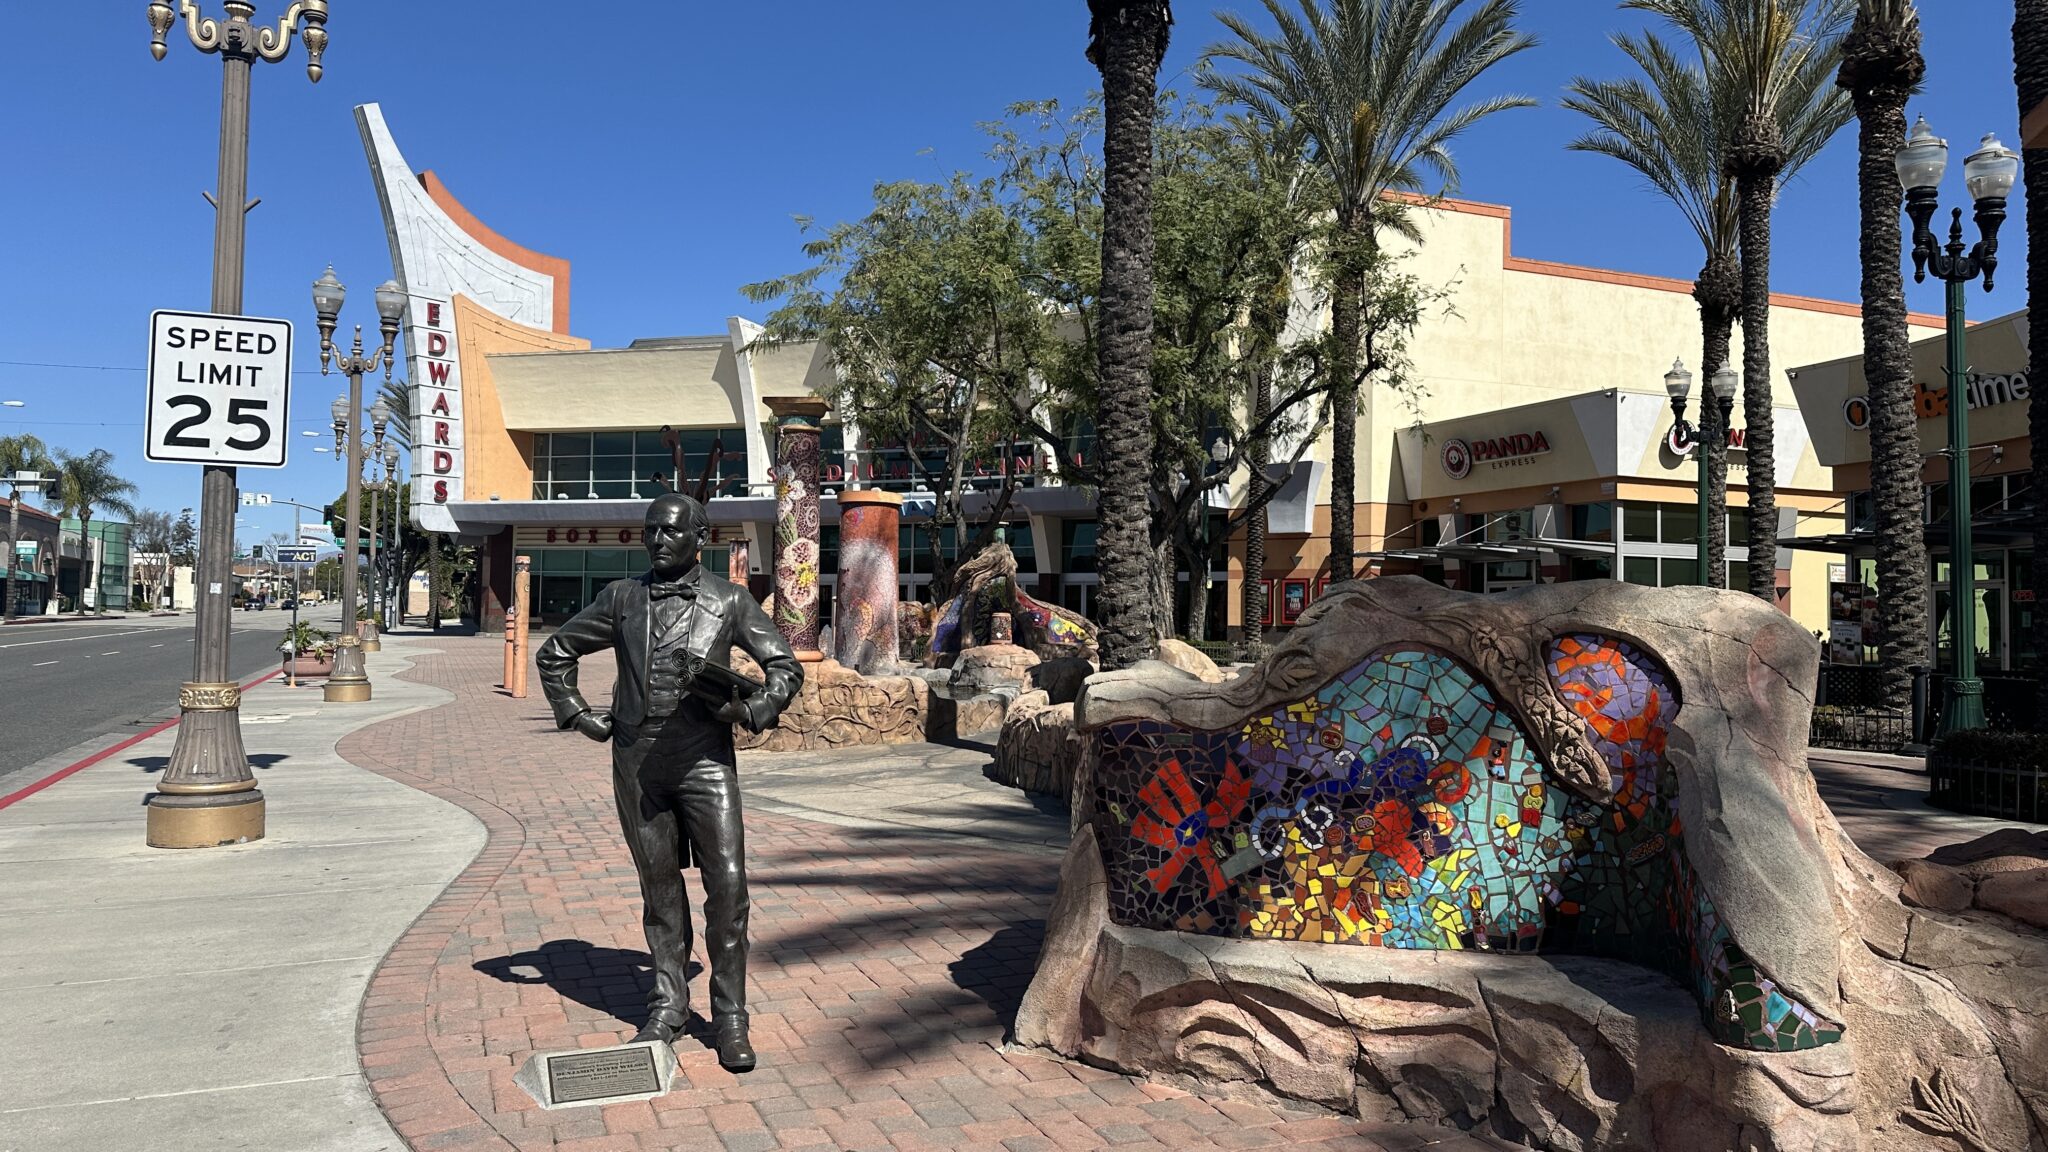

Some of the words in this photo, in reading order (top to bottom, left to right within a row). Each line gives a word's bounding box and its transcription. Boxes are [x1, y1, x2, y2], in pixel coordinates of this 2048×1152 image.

[166, 326, 277, 355] SPEED
[177, 361, 263, 387] LIMIT
[426, 302, 453, 504] EDWARDS
[163, 394, 271, 451] 25
[1471, 430, 1551, 462] PANDA
[1491, 457, 1537, 470] EXPRESS
[546, 528, 599, 544] BOX
[292, 551, 316, 562] ACT
